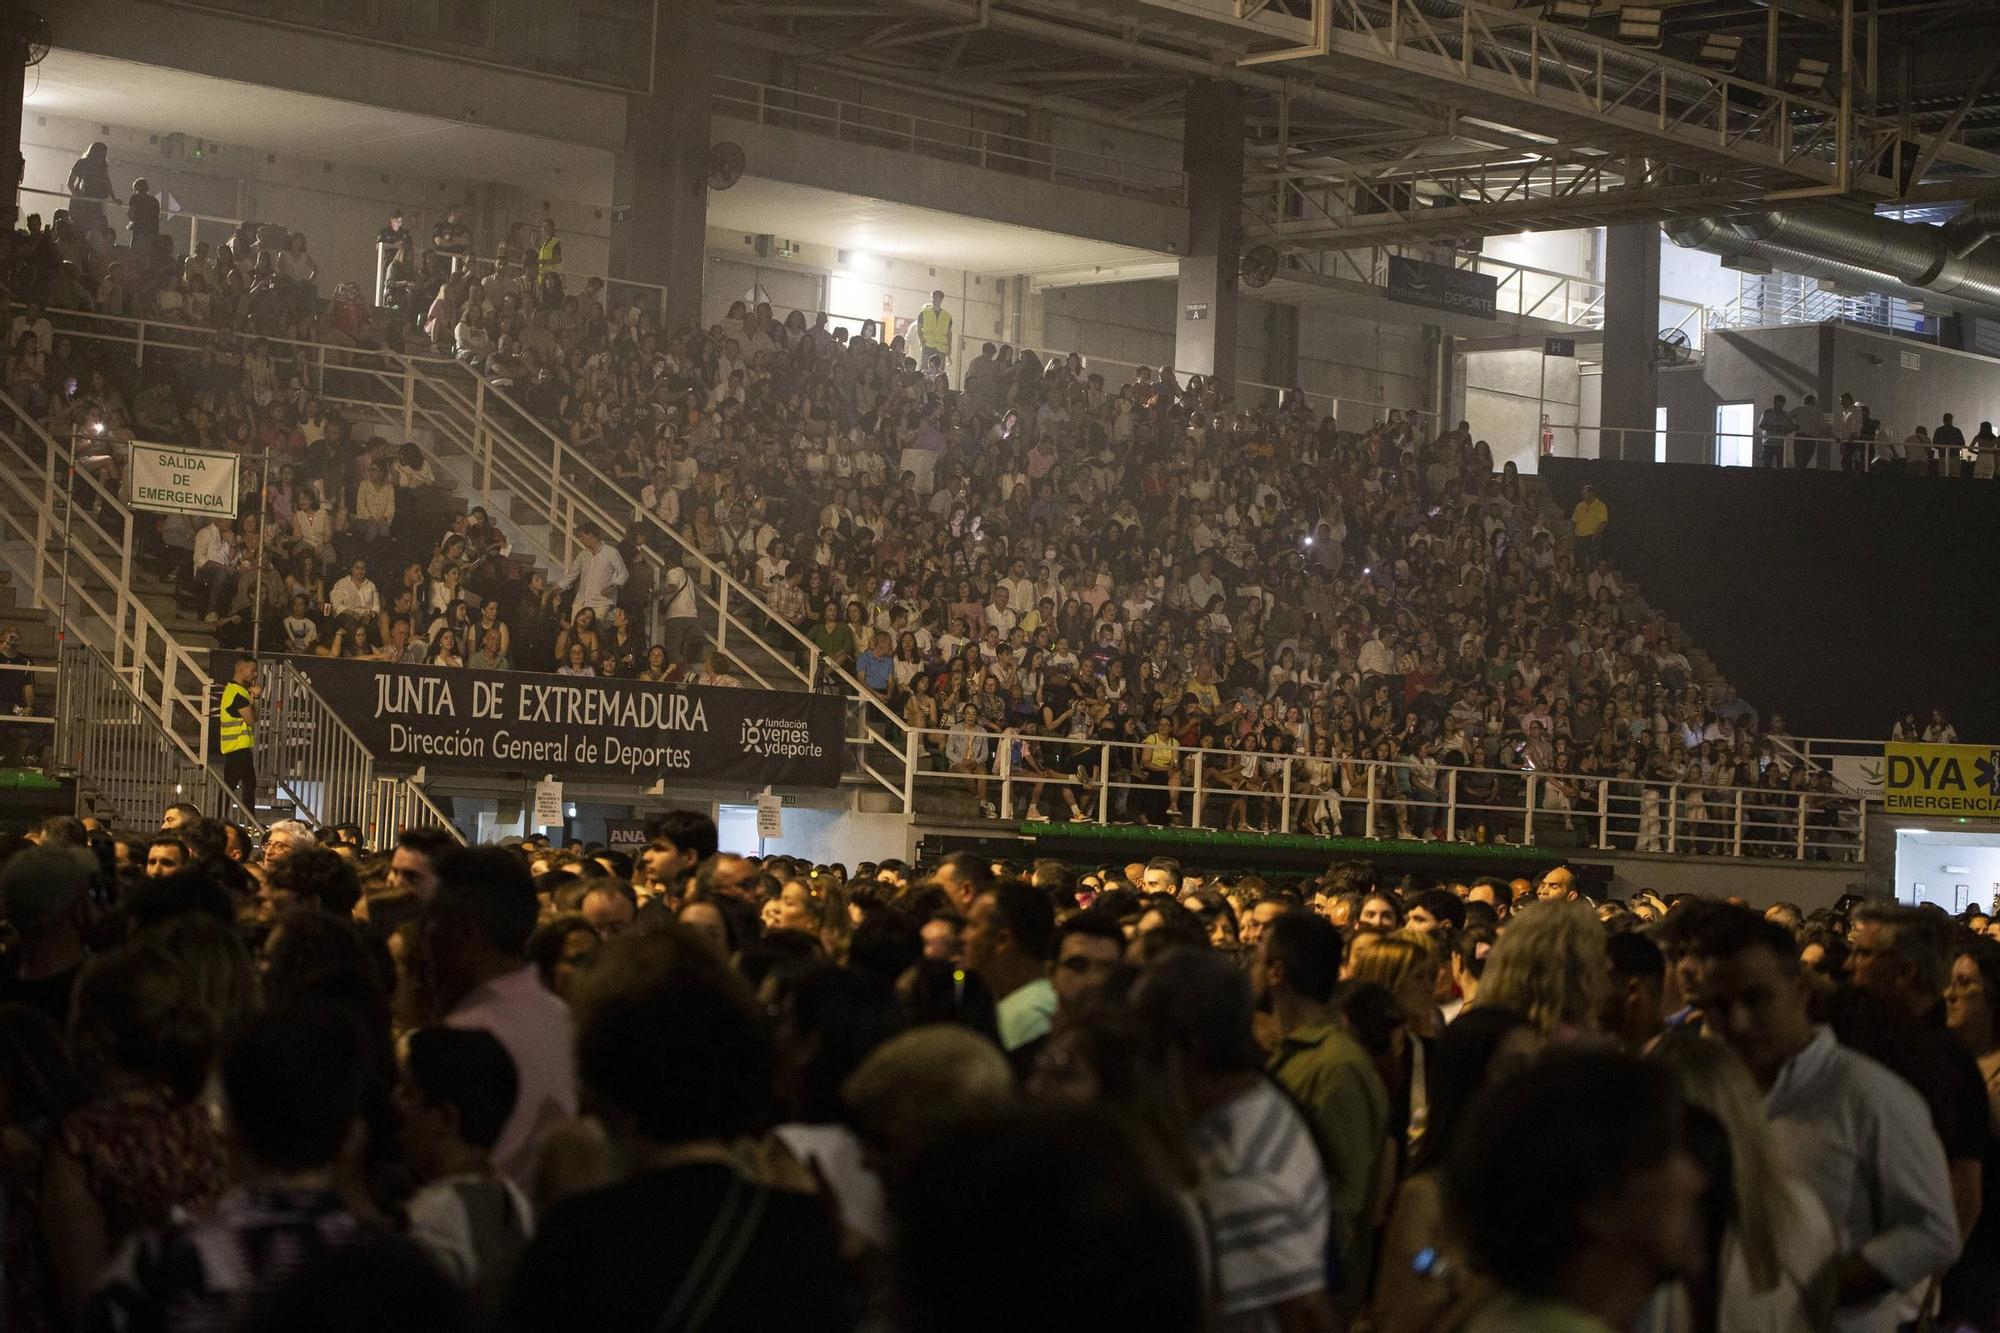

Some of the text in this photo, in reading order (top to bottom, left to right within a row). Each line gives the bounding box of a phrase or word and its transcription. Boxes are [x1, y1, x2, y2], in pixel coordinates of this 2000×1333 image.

[1444, 291, 1495, 312] DEPORTE
[1193, 311, 1199, 319] A
[1551, 342, 1561, 353] H
[159, 454, 206, 471] SALIDA
[173, 473, 190, 487] DE
[138, 486, 224, 507] EMERGENCIA
[374, 673, 709, 732] JUNTA DE EXTREMADURA
[765, 717, 808, 729] fundación
[389, 723, 691, 775] Dirección General de Deportes
[764, 741, 823, 759] ydeporte
[1887, 755, 1967, 791] DYA
[610, 829, 647, 843] ANA
